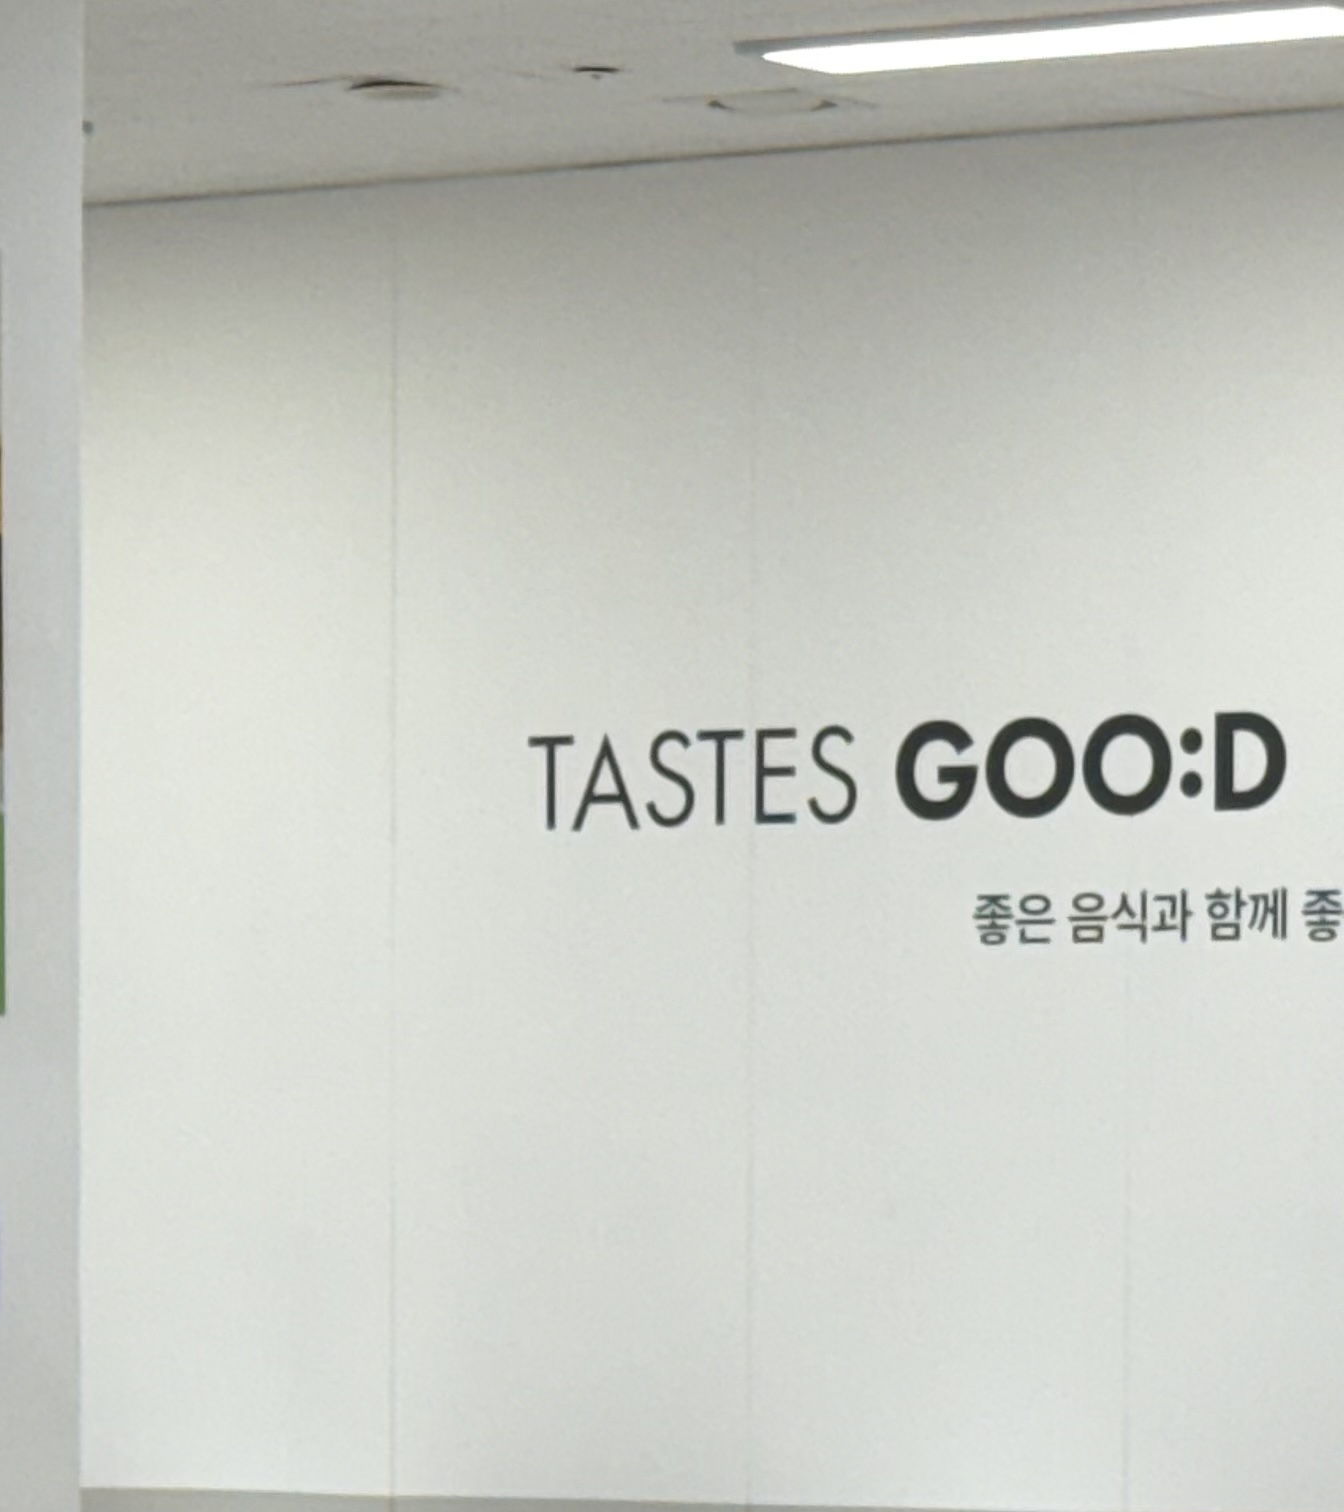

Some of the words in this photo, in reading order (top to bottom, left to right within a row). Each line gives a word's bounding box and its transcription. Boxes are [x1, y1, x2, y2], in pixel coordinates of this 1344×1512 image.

[528, 725, 858, 832] TASTES
[895, 711, 1287, 821] GOO:D
[972, 893, 1056, 946] 좋은
[1067, 889, 1194, 945] 음식과
[1204, 887, 1288, 942] 함께
